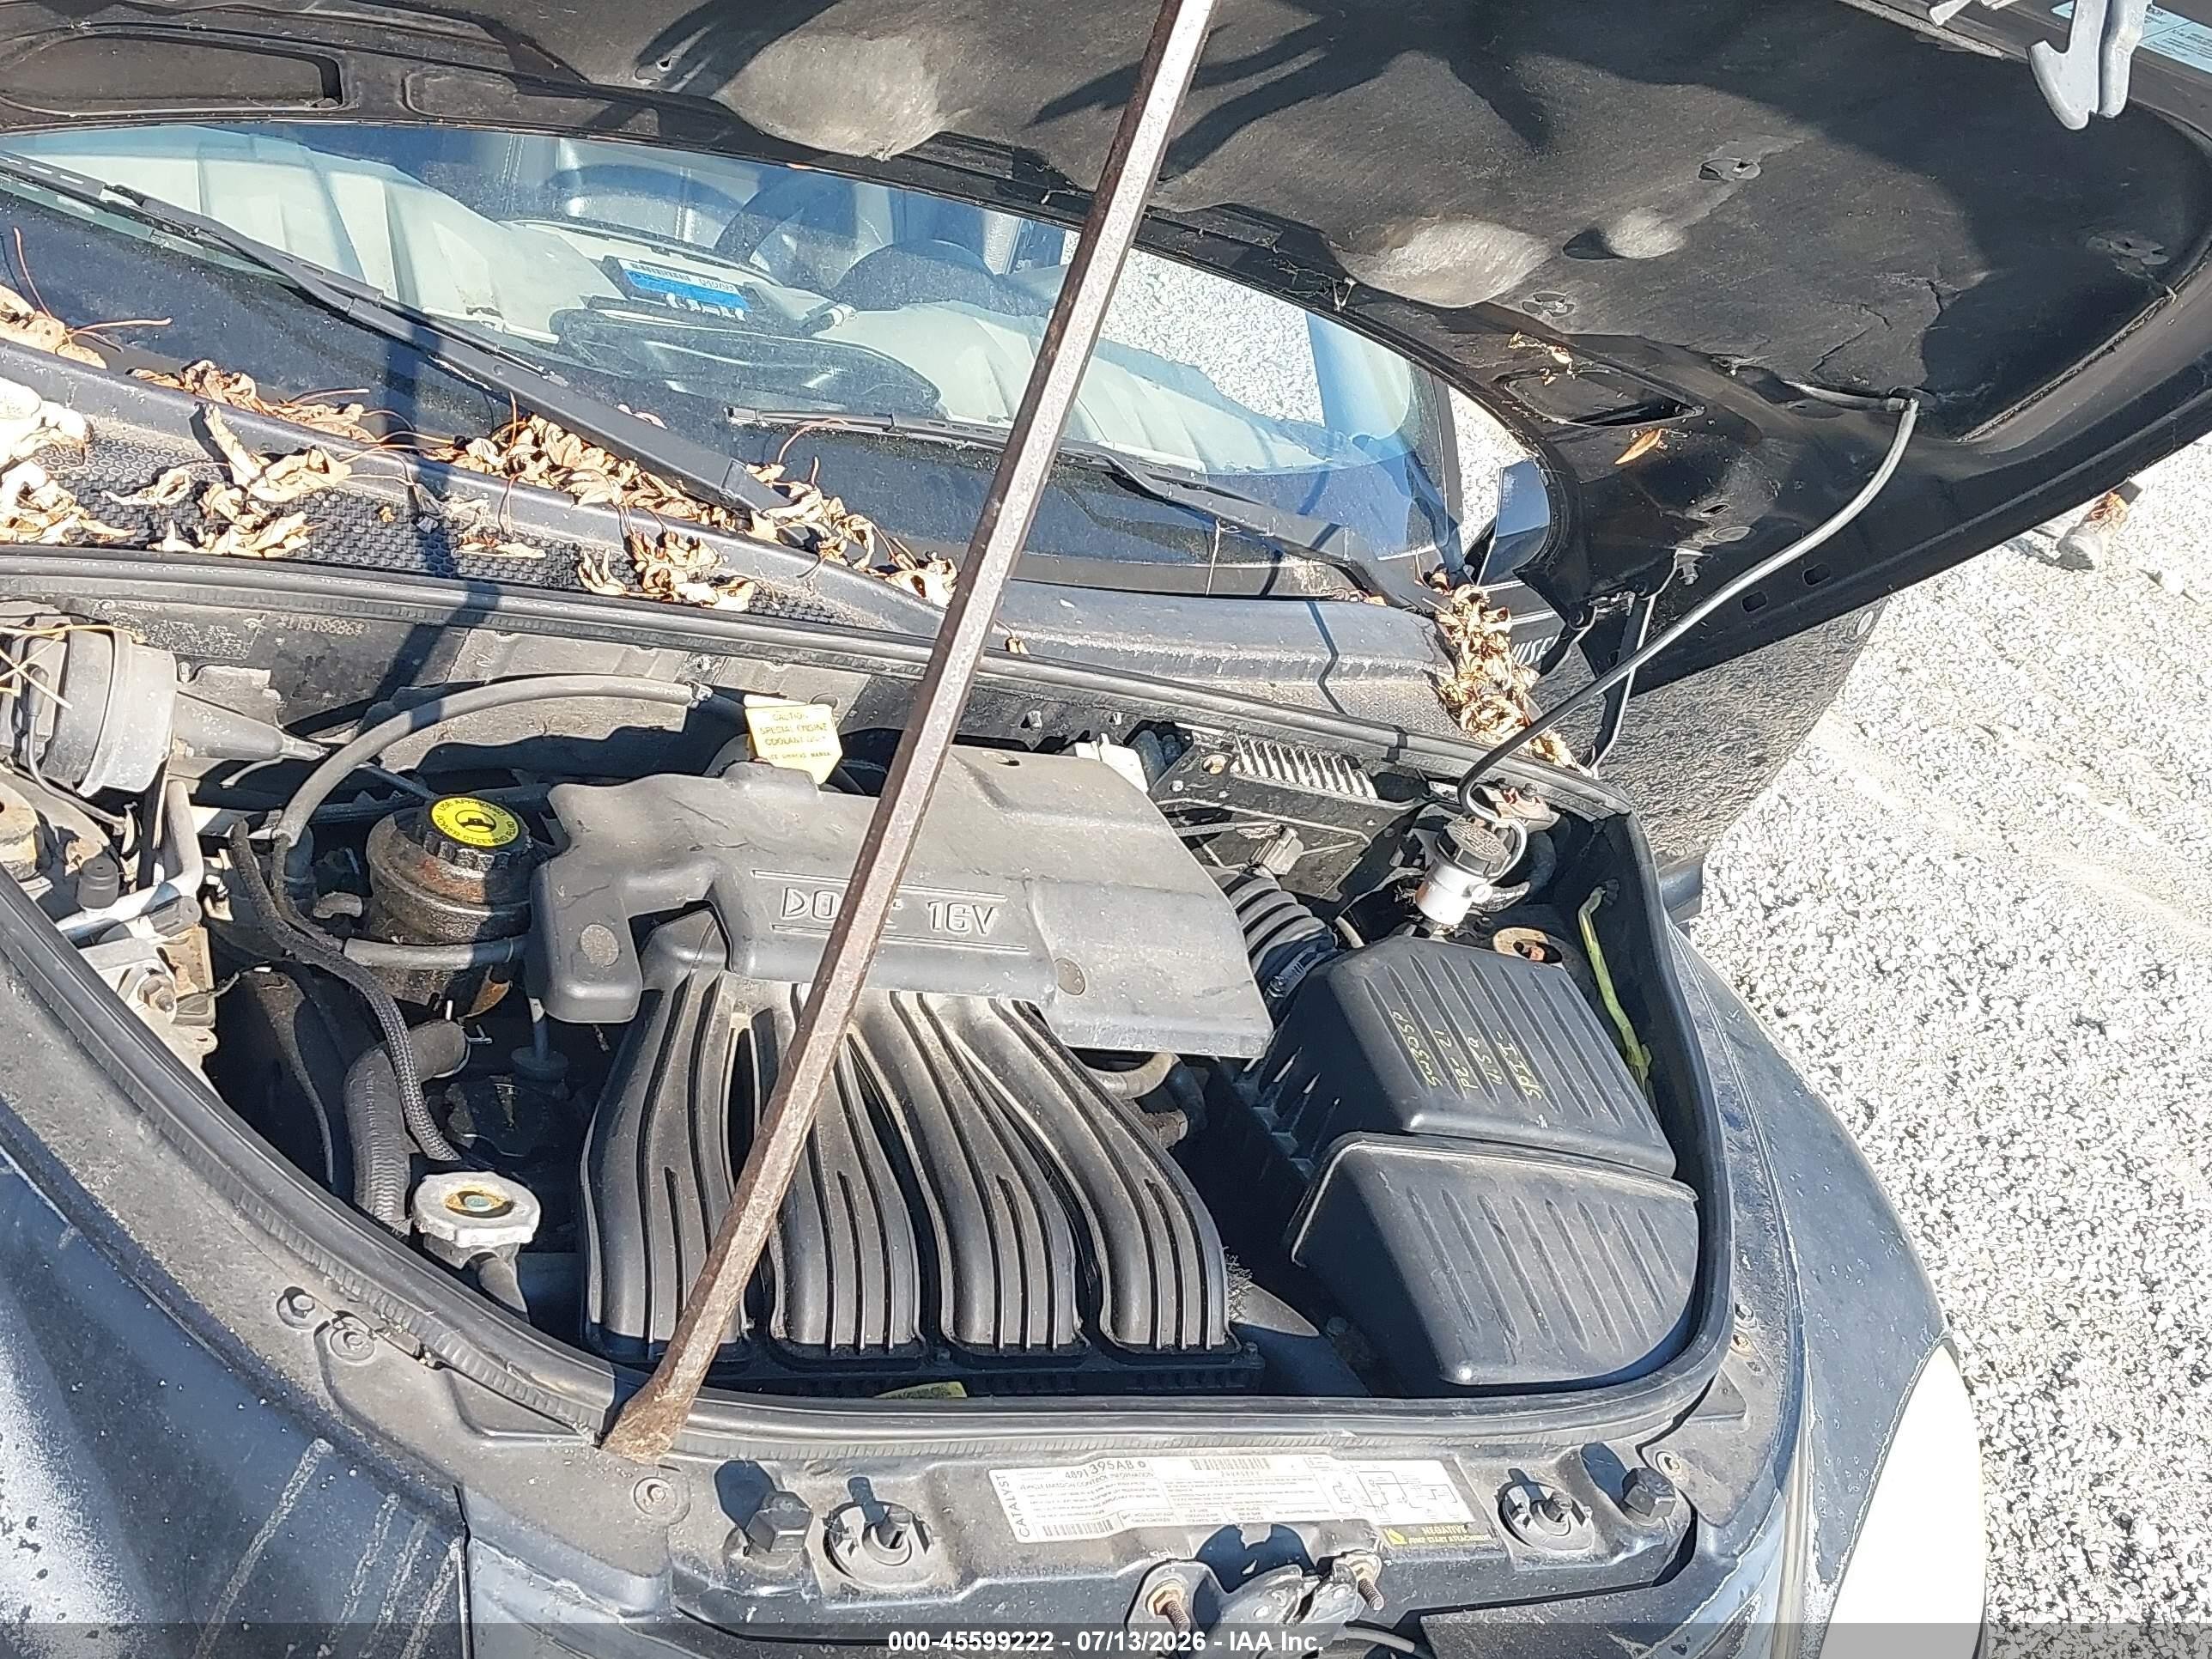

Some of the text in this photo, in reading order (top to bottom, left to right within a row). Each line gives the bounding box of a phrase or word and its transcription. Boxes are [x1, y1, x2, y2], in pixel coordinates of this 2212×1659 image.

[439, 799, 507, 817] USE APPROVED
[435, 814, 515, 845] POWER STEERING FLUID
[927, 900, 995, 934] 16V
[995, 1474, 1030, 1538] CATALYST
[1421, 1524, 1468, 1534] NEGATIVE
